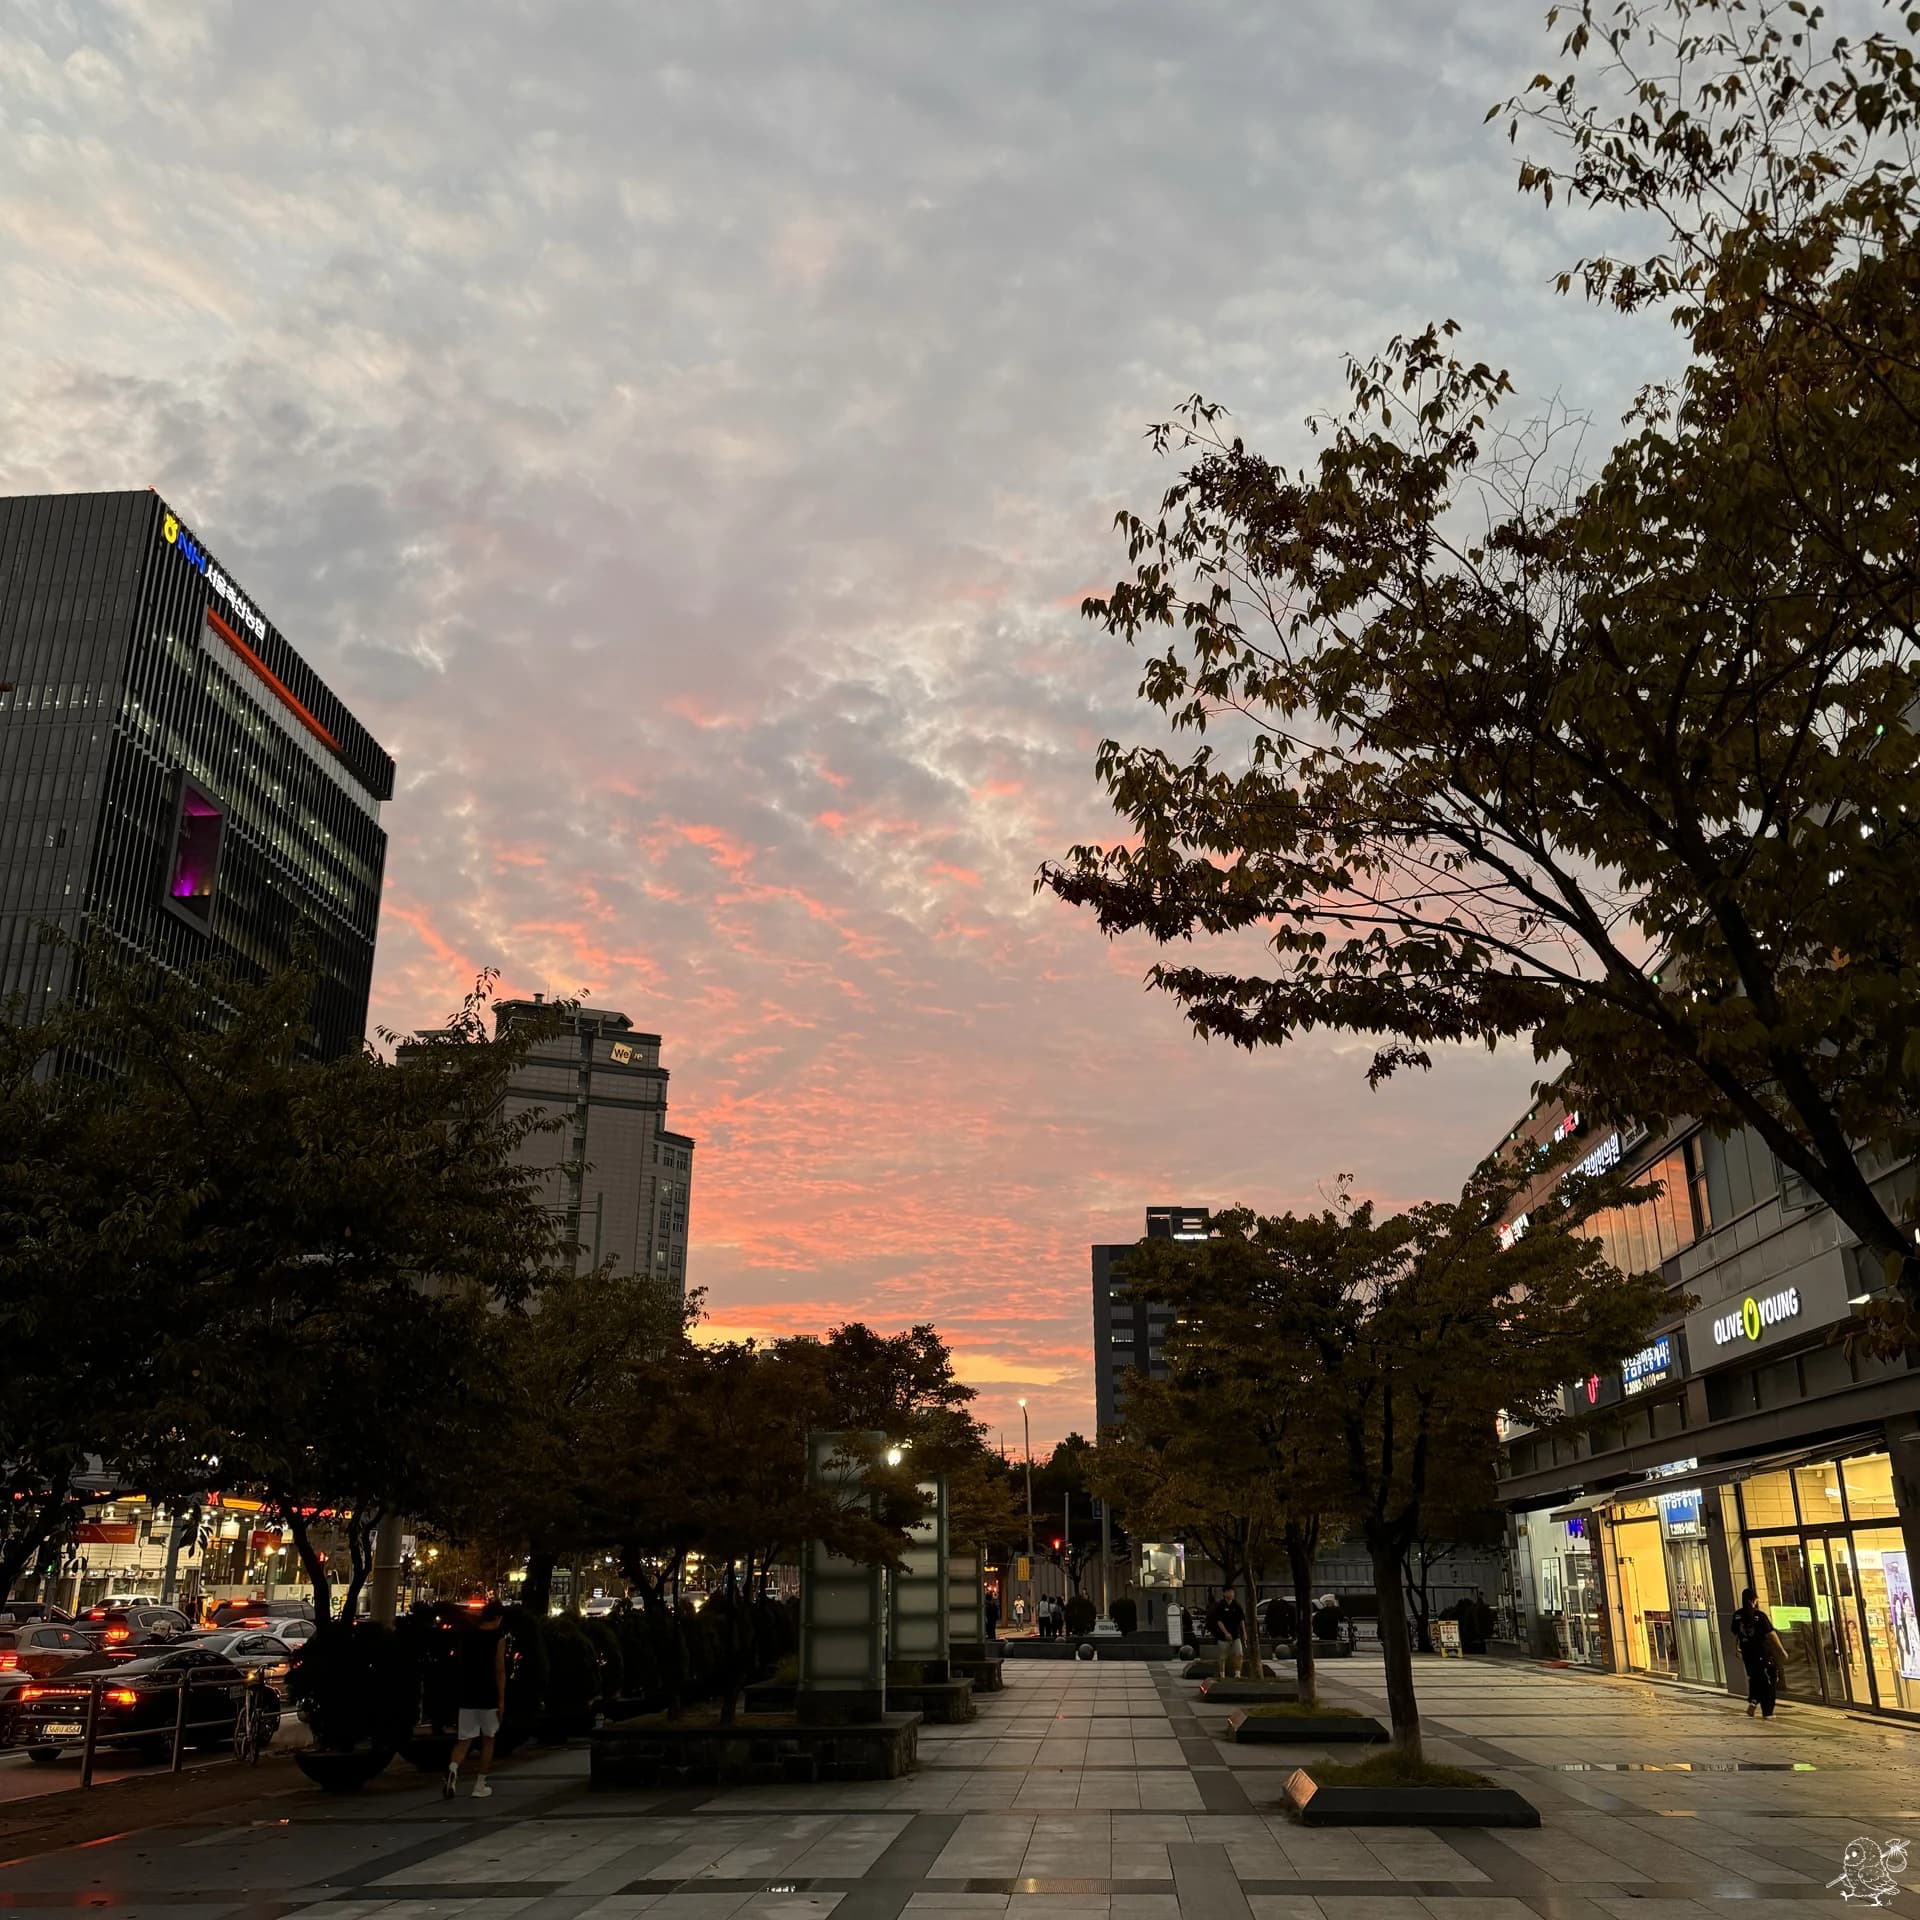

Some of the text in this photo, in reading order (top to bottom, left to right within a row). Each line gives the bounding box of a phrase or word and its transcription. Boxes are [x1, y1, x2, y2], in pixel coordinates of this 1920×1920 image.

[177, 531, 266, 640] NH 서울축산농협
[1713, 1287, 1799, 1345] OLIVE YOUNG
